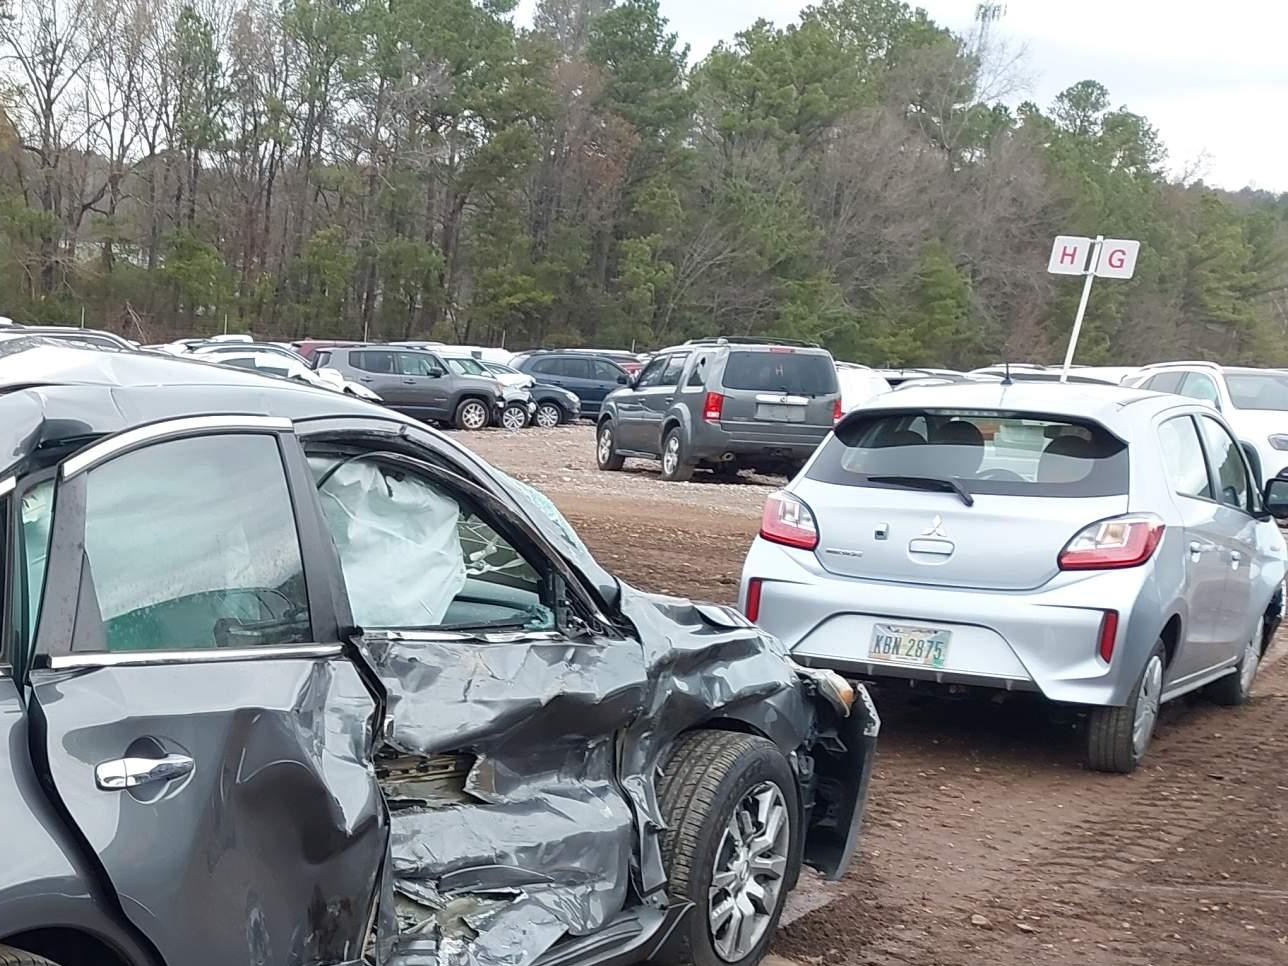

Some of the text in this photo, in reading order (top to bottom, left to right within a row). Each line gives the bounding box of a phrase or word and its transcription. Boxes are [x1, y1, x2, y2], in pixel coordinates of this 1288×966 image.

[1060, 245, 1127, 269] H G
[775, 363, 784, 377] H
[872, 634, 945, 661] KBN 2875
